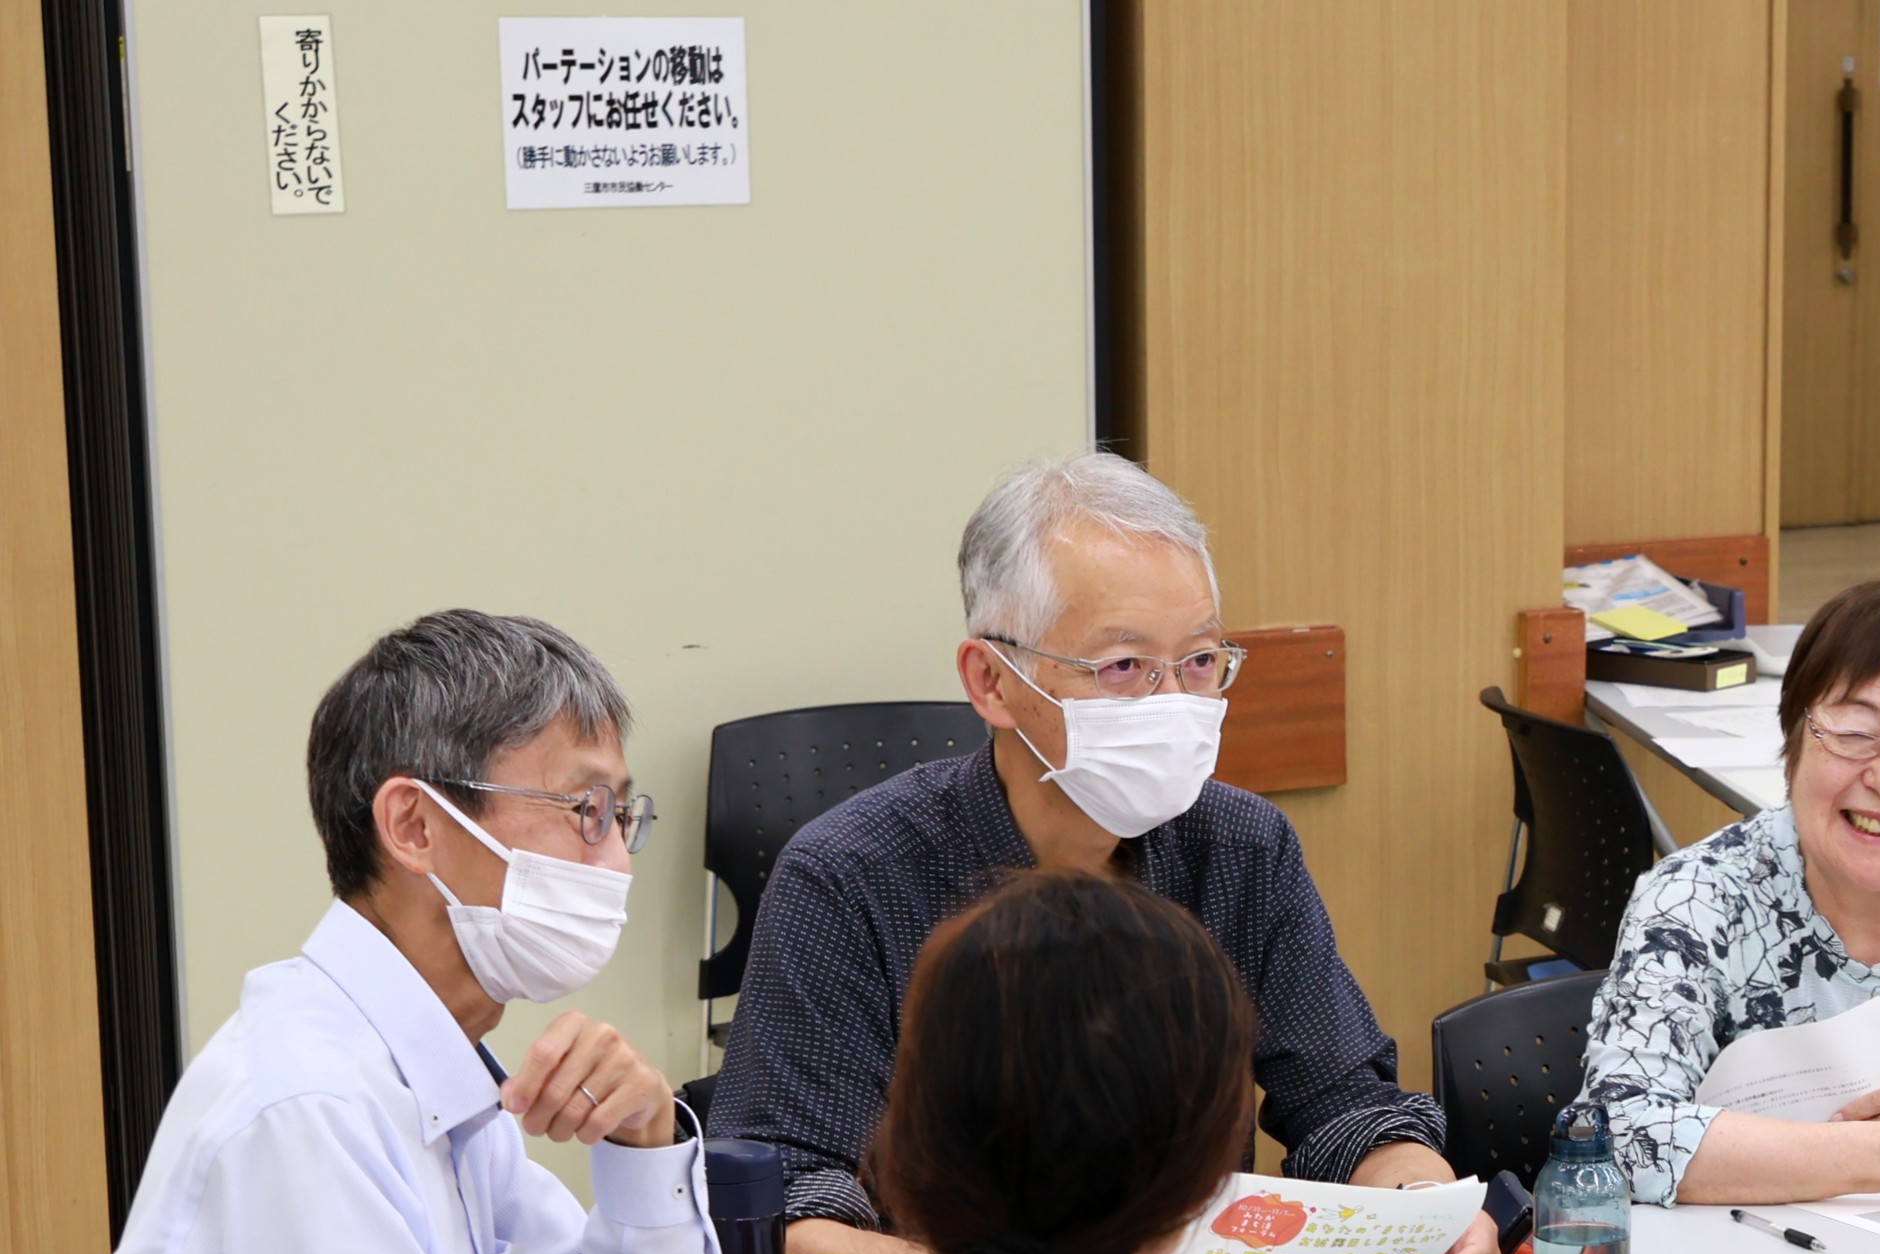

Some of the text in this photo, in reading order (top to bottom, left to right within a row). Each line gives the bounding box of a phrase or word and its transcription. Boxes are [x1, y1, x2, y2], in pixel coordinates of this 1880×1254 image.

[522, 45, 724, 85] パーテーションの移動は
[295, 28, 333, 205] 寄りかからないで
[511, 90, 739, 131] スタッフにお任せください。
[271, 101, 304, 198] ください。
